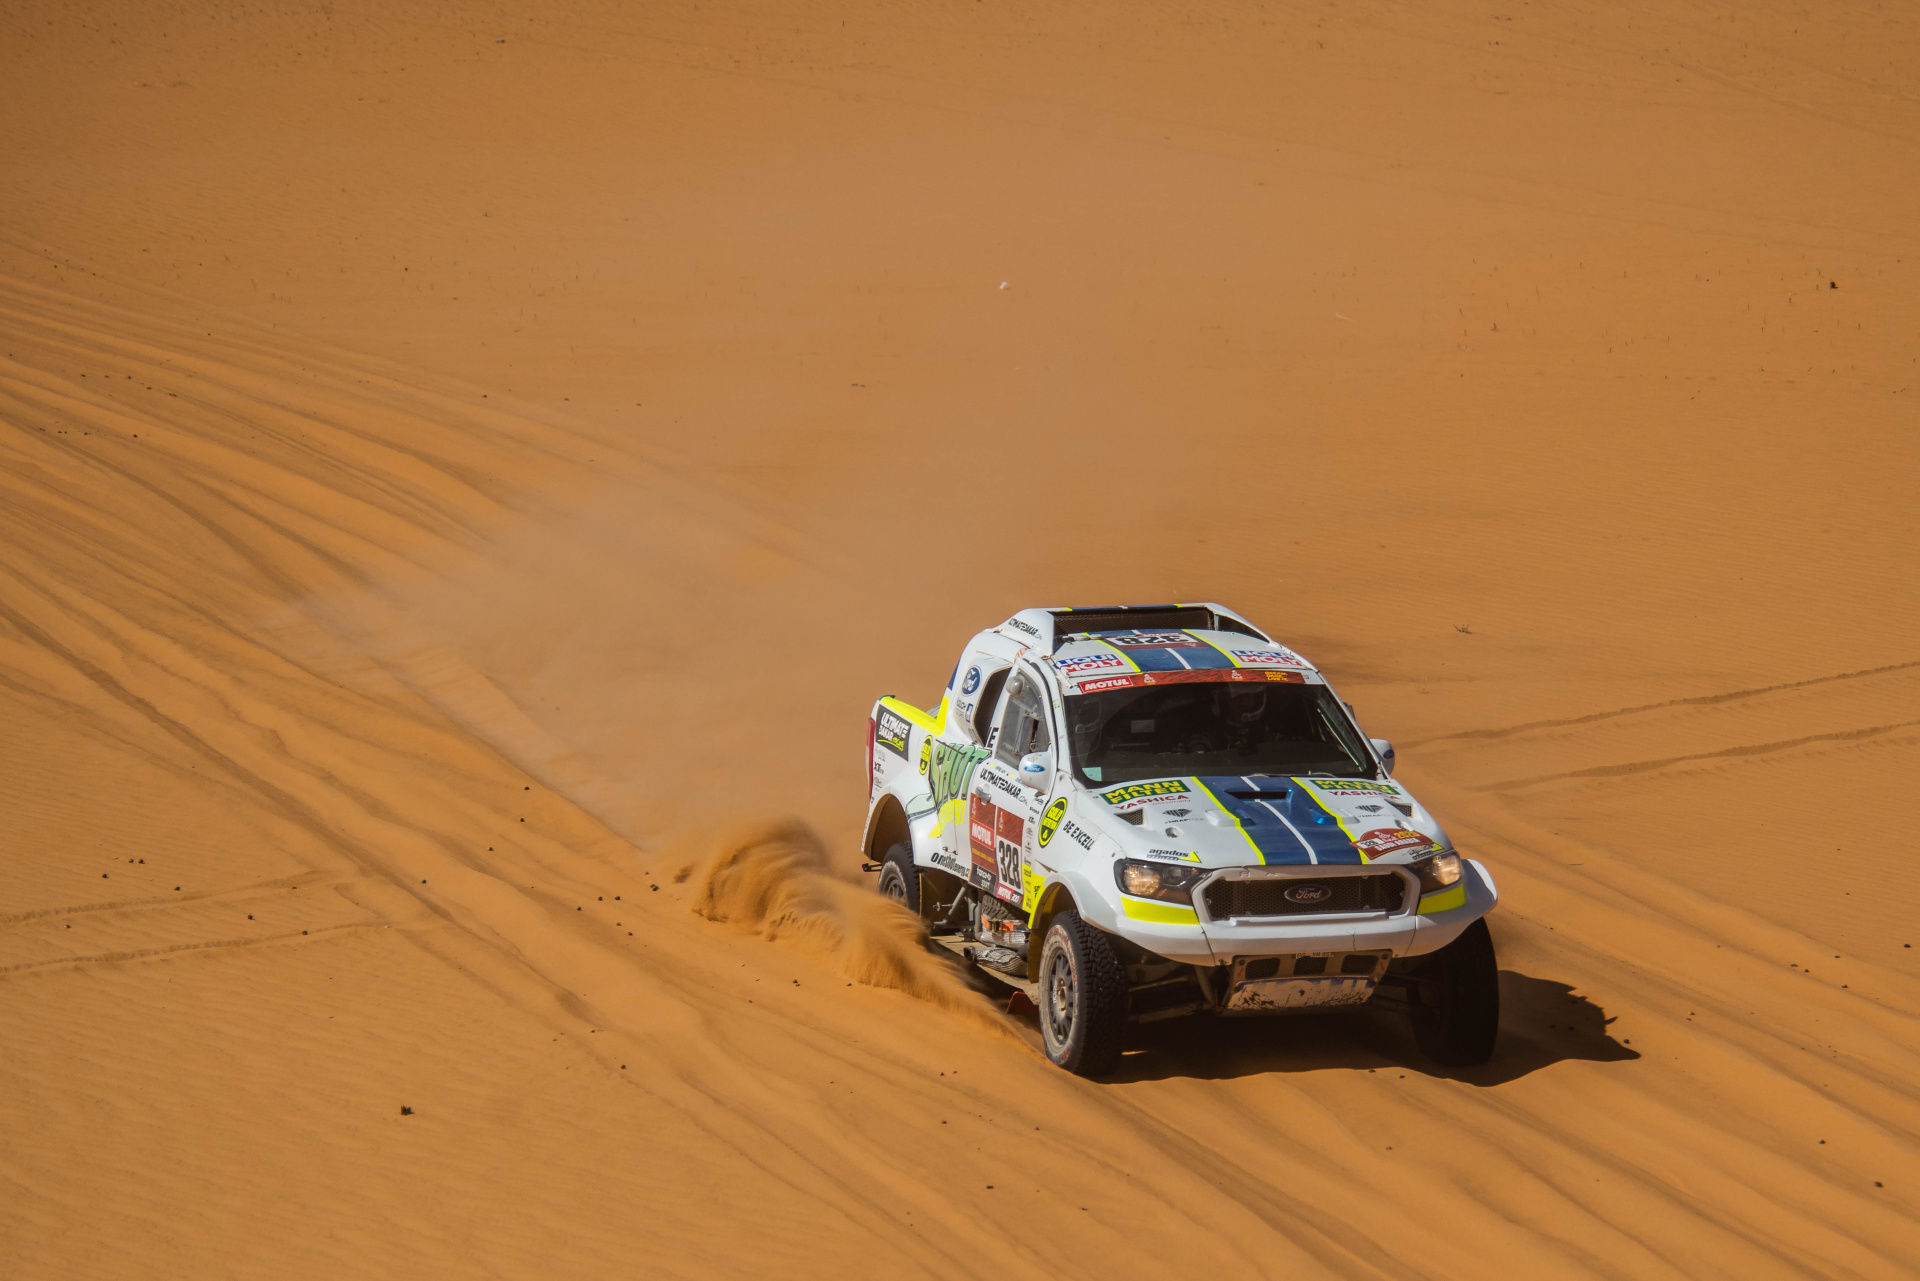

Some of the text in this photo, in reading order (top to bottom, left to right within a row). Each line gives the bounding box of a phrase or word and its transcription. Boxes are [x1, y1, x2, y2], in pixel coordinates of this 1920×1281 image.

[1115, 634, 1190, 645] 328
[1053, 653, 1117, 669] LIQUI
[1060, 659, 1124, 672] MOLY
[1084, 679, 1131, 691] MOTUL
[1105, 781, 1181, 800] MANN
[1110, 786, 1185, 804] FILTER
[1114, 794, 1189, 810] YASHICA
[971, 822, 992, 846] MOTUL
[1063, 820, 1074, 835] BE
[1069, 826, 1096, 851] EXCELL
[1148, 848, 1189, 858] agados
[998, 840, 1022, 889] 328
[1295, 888, 1322, 899] Ford
